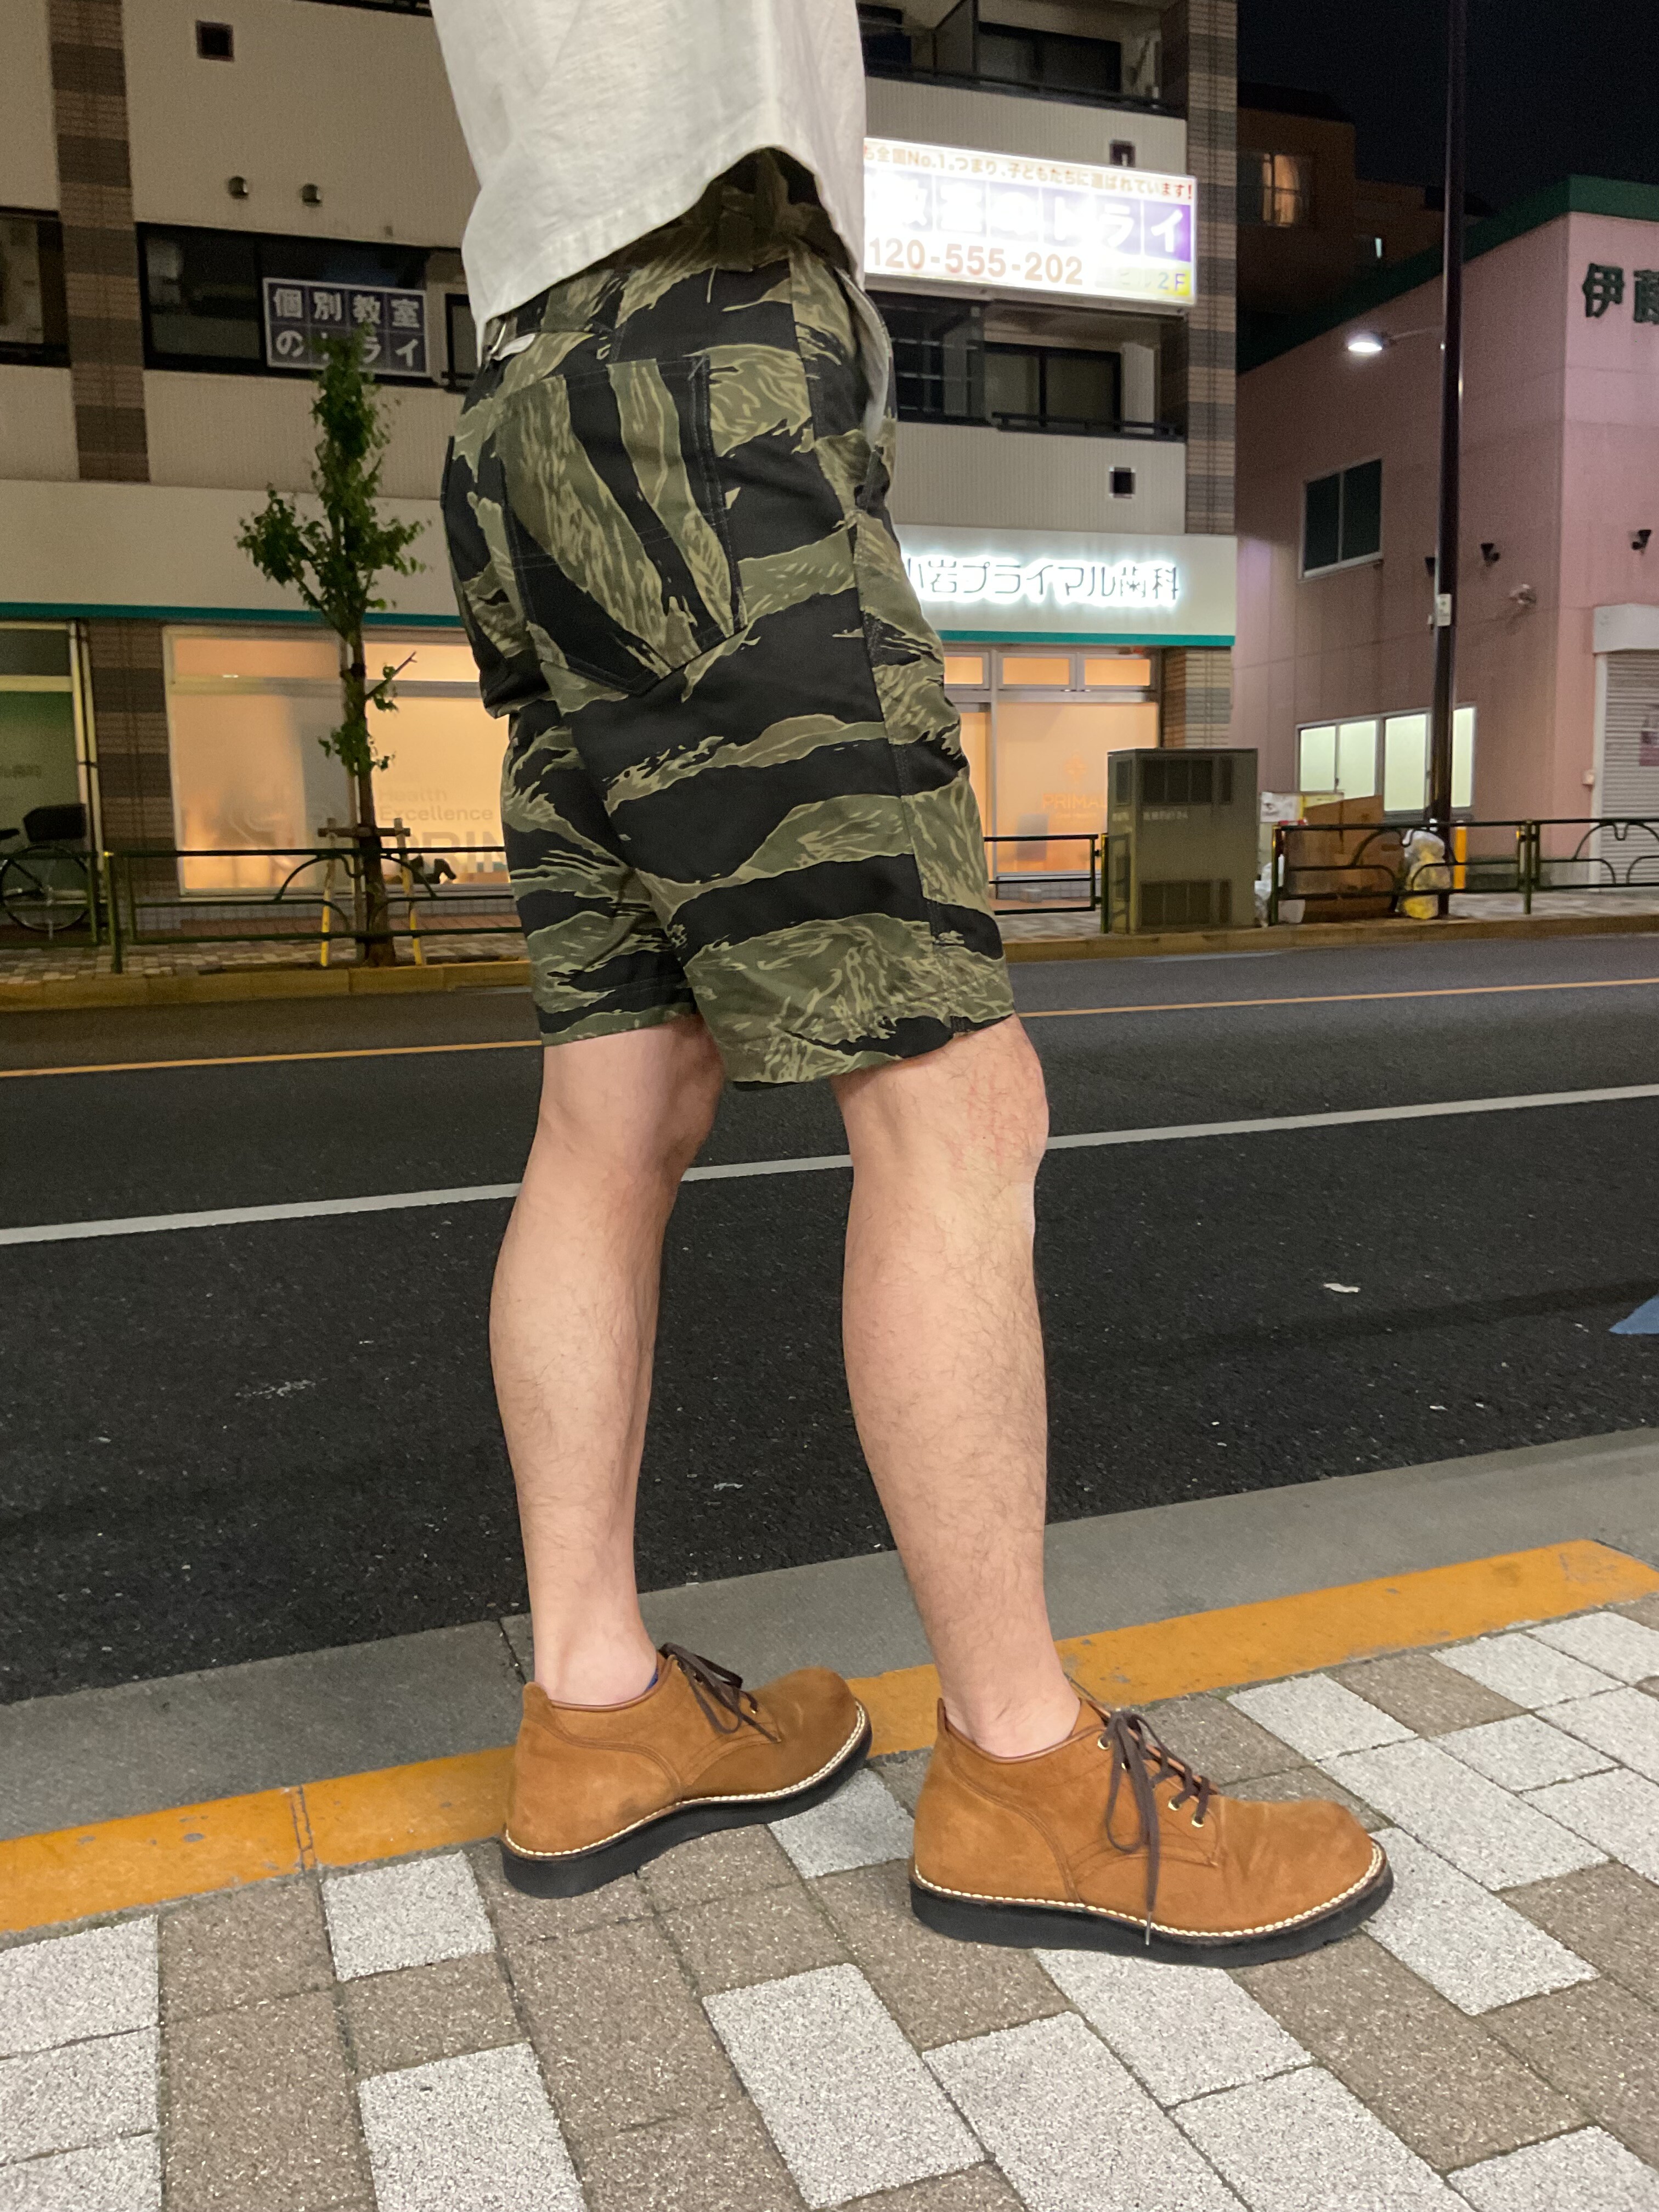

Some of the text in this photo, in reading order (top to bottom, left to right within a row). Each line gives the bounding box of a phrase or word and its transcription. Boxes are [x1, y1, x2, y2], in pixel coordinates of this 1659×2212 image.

[273, 287, 420, 329] 個別教室
[275, 330, 419, 368] のライ
[379, 804, 493, 821] Excellence
